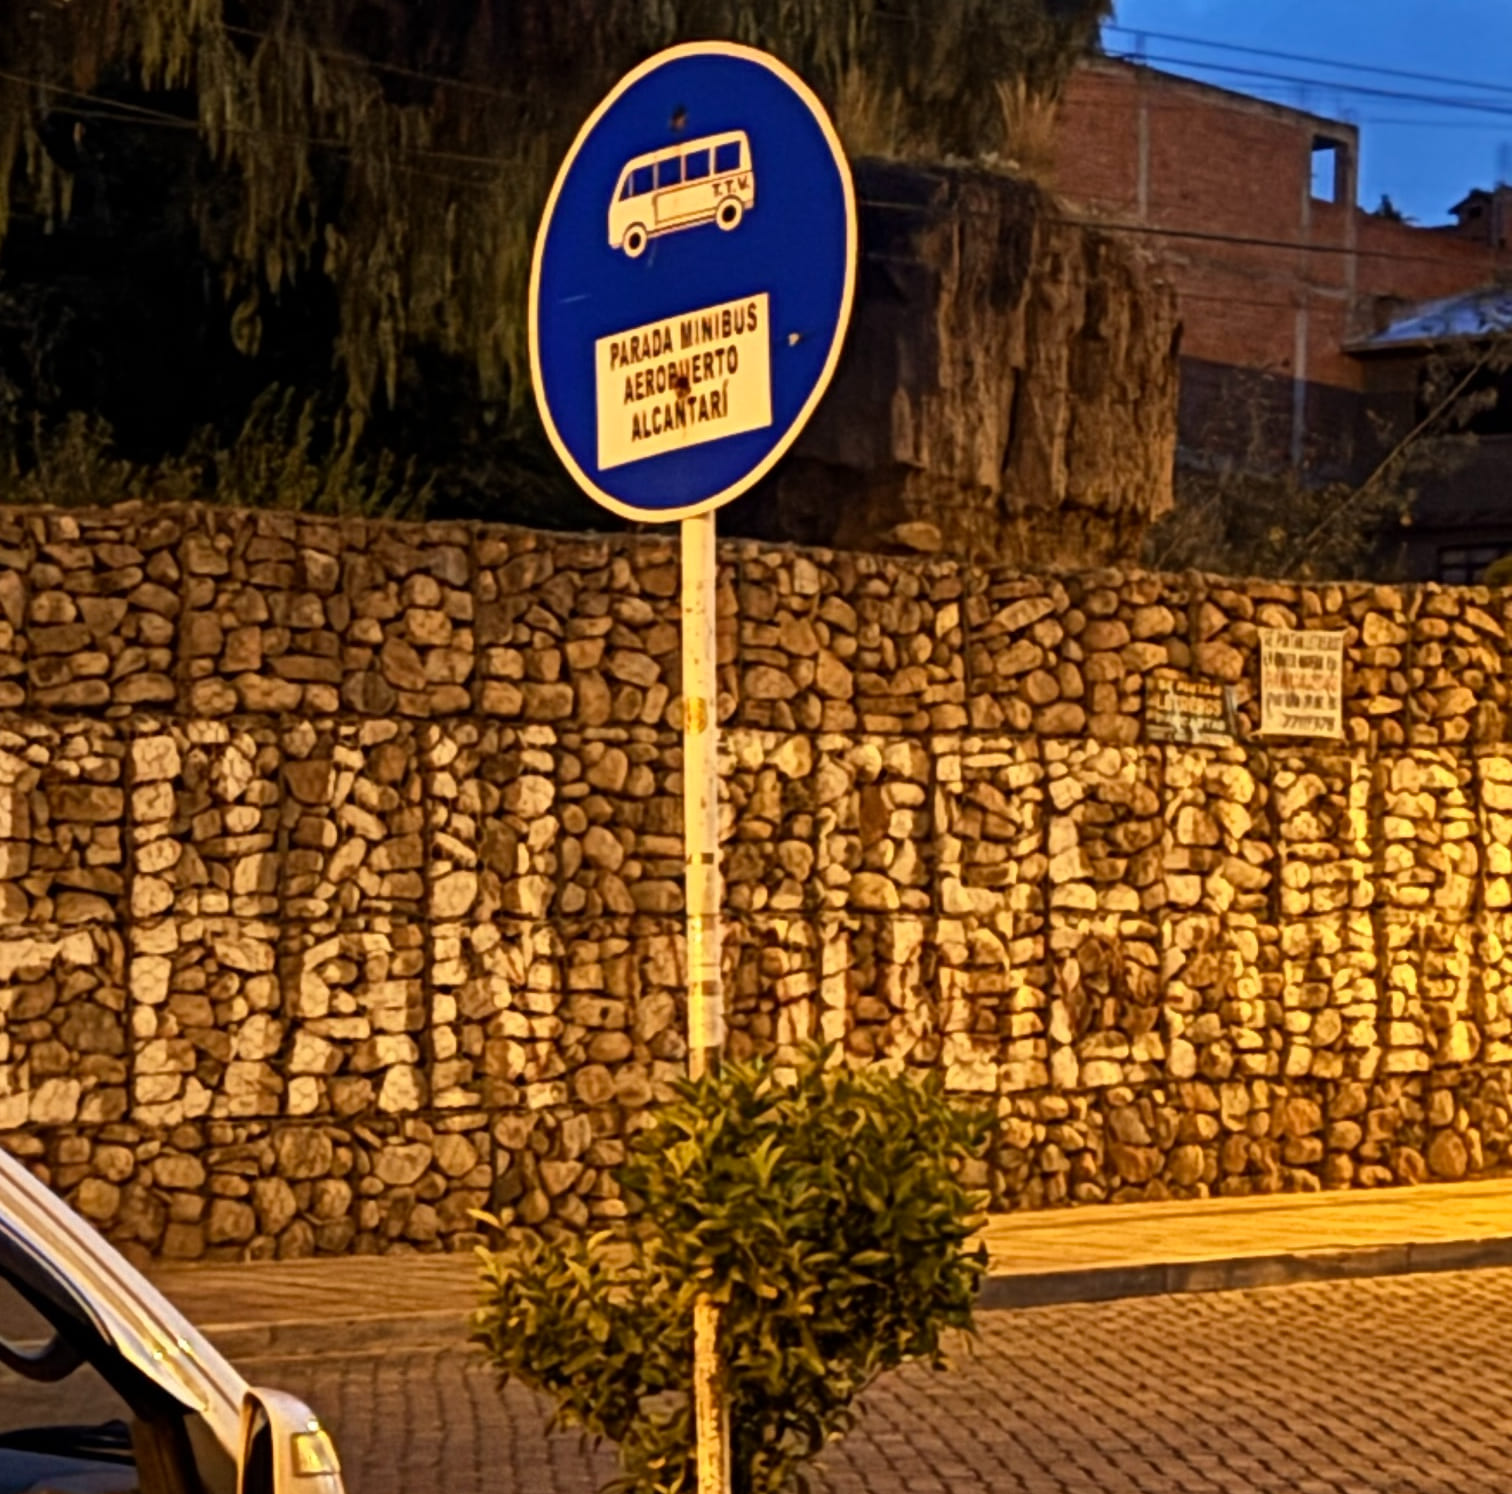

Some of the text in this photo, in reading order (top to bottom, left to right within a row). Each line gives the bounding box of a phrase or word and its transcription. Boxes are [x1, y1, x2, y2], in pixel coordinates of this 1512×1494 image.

[609, 302, 758, 371] PARADA MINIBUS
[623, 345, 739, 405] AEROPUERTO
[631, 379, 730, 442] ALCANTARÍ
